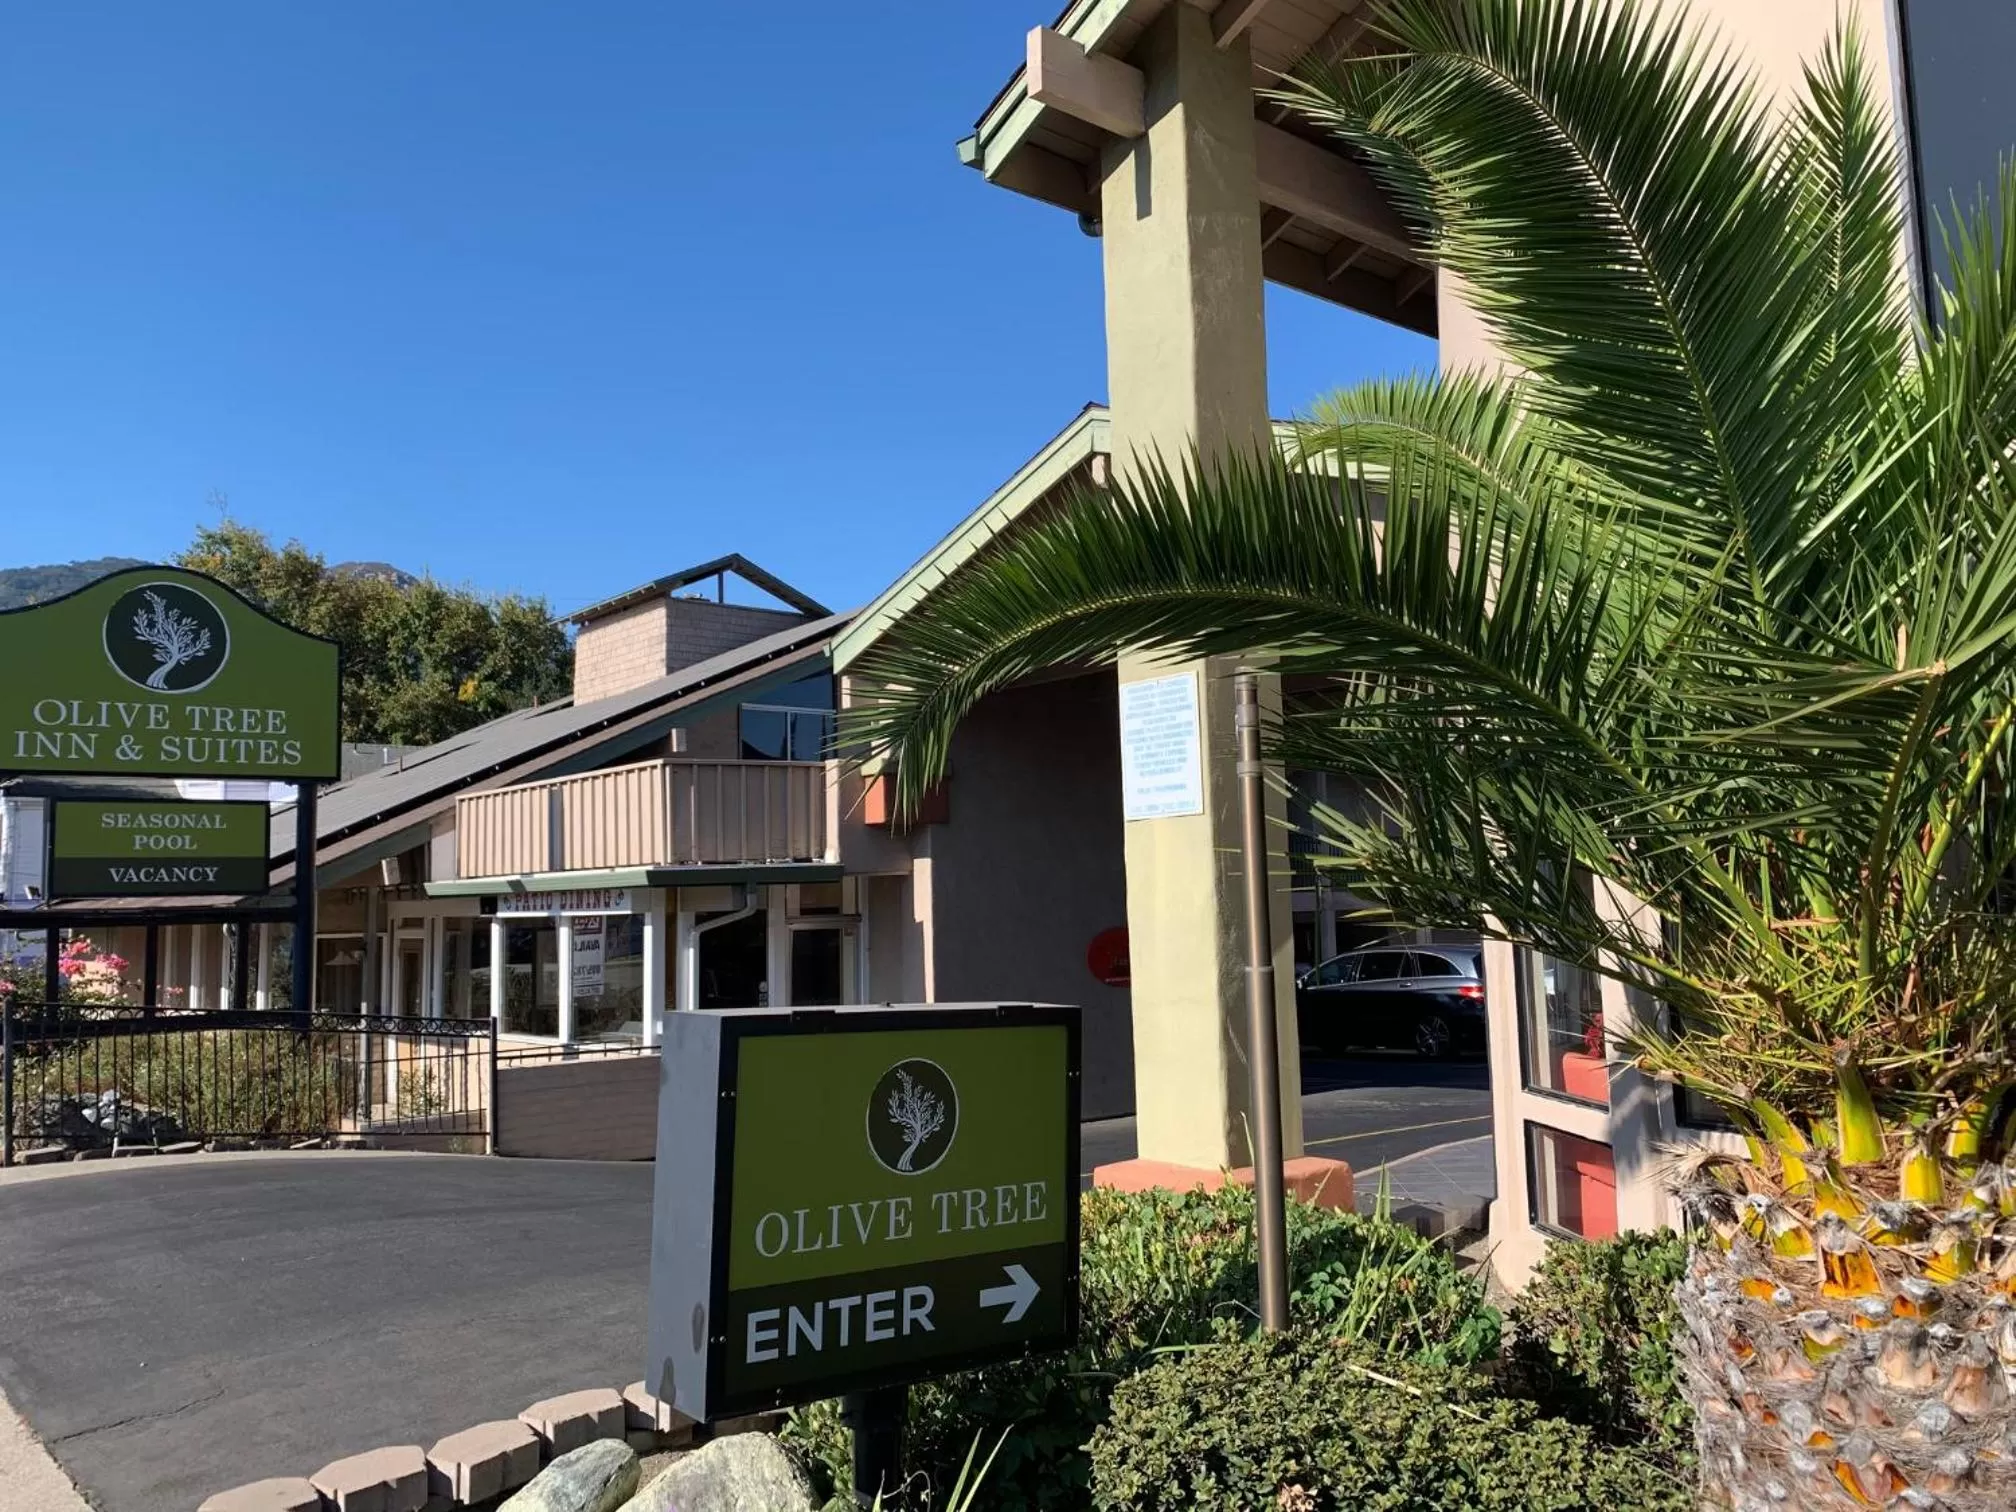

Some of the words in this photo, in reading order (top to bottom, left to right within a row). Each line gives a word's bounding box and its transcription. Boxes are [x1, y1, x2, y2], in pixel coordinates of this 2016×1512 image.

[33, 699, 170, 730] OLIVE
[185, 705, 288, 735] TREE
[14, 731, 99, 760] INN
[115, 734, 143, 762] &
[160, 736, 303, 765] SUITES
[101, 812, 227, 830] SEASONAL
[133, 834, 198, 851] POOL
[108, 866, 220, 883] VACANCY
[515, 892, 553, 911] PATIO
[559, 889, 611, 909] DINING
[754, 1197, 913, 1258] OLIVE
[930, 1181, 1048, 1235] TREE
[745, 1285, 936, 1364] ENTER
